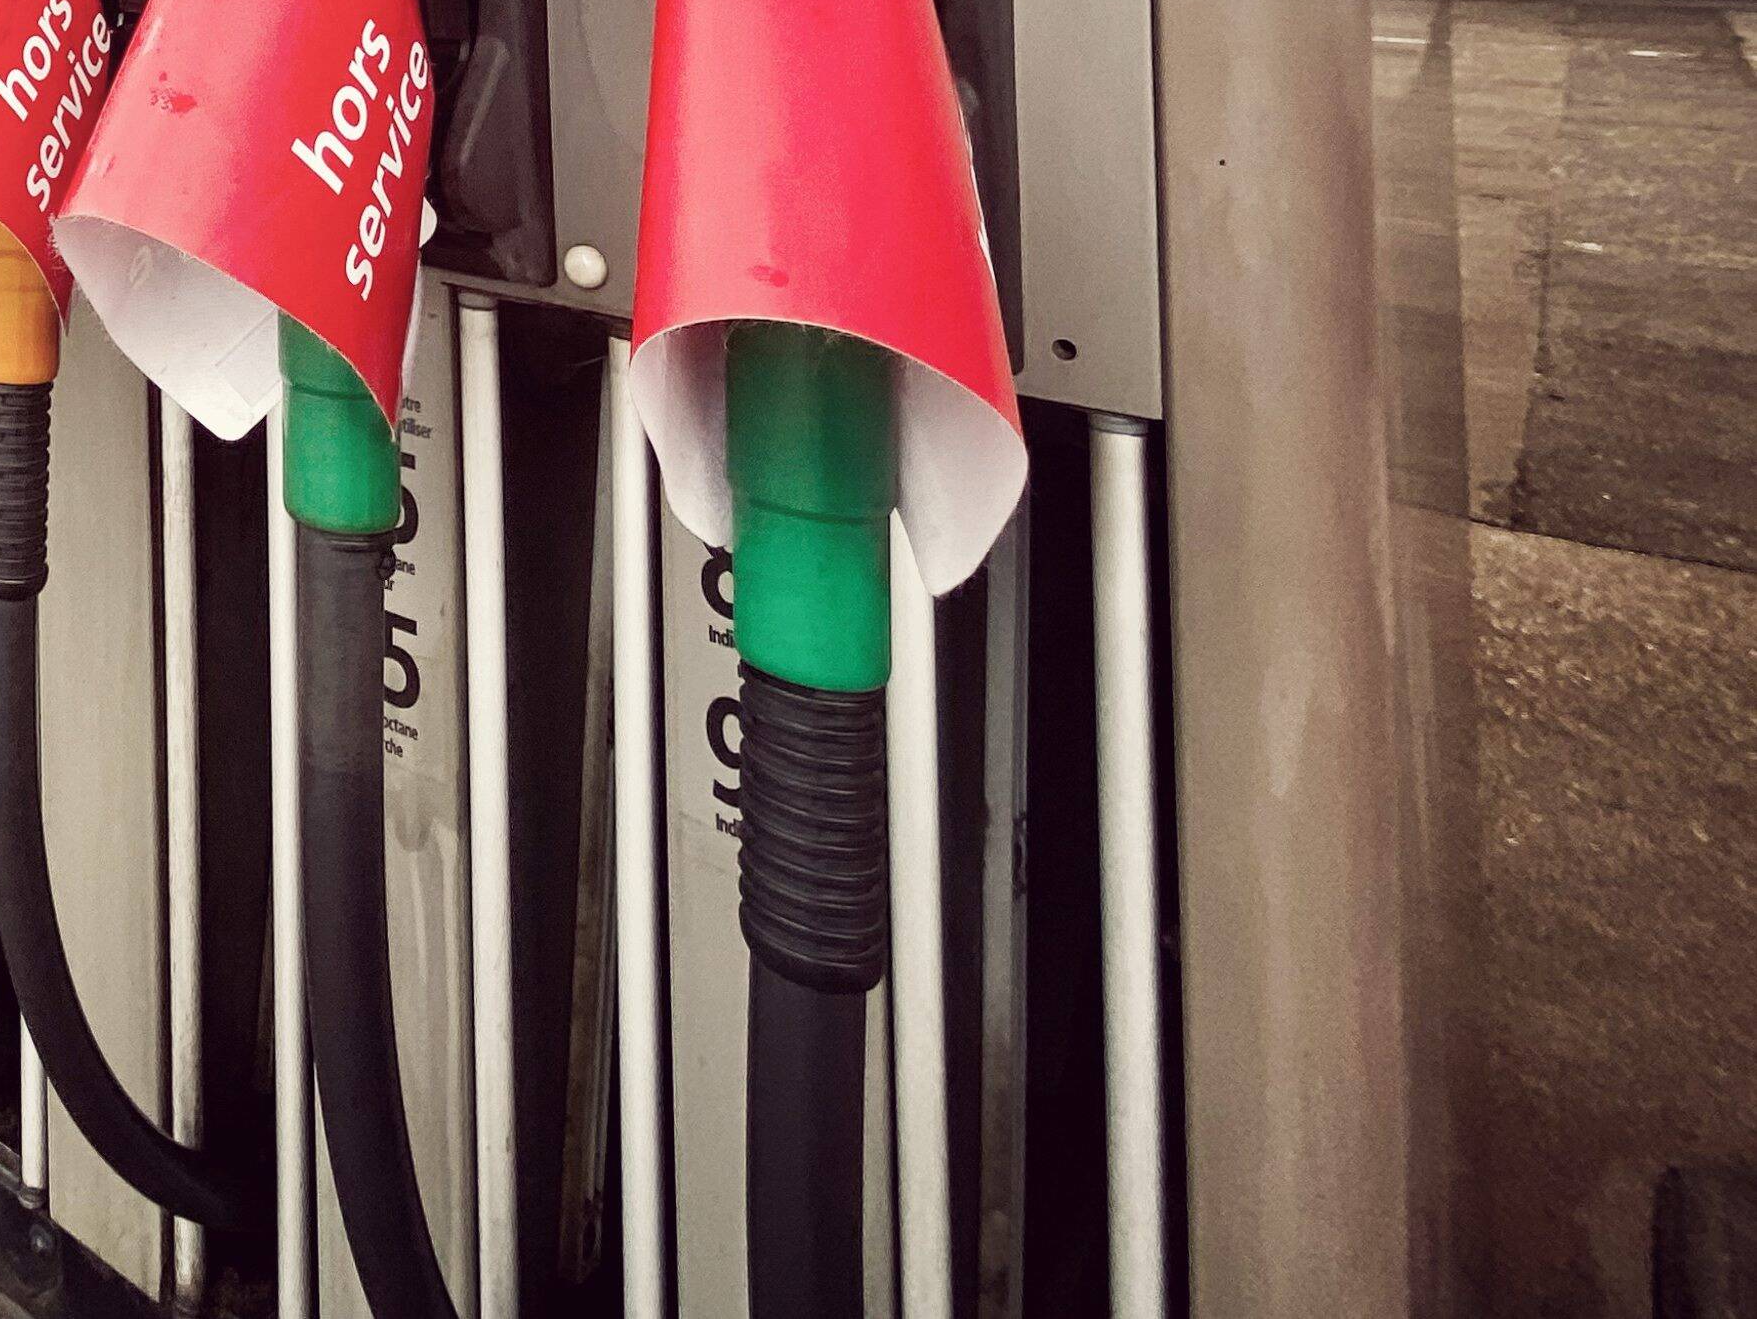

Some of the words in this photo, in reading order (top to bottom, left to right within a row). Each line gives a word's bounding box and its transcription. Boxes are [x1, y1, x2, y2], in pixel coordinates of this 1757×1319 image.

[26, 13, 112, 212] service
[292, 18, 391, 196] hors
[345, 41, 428, 302] service
